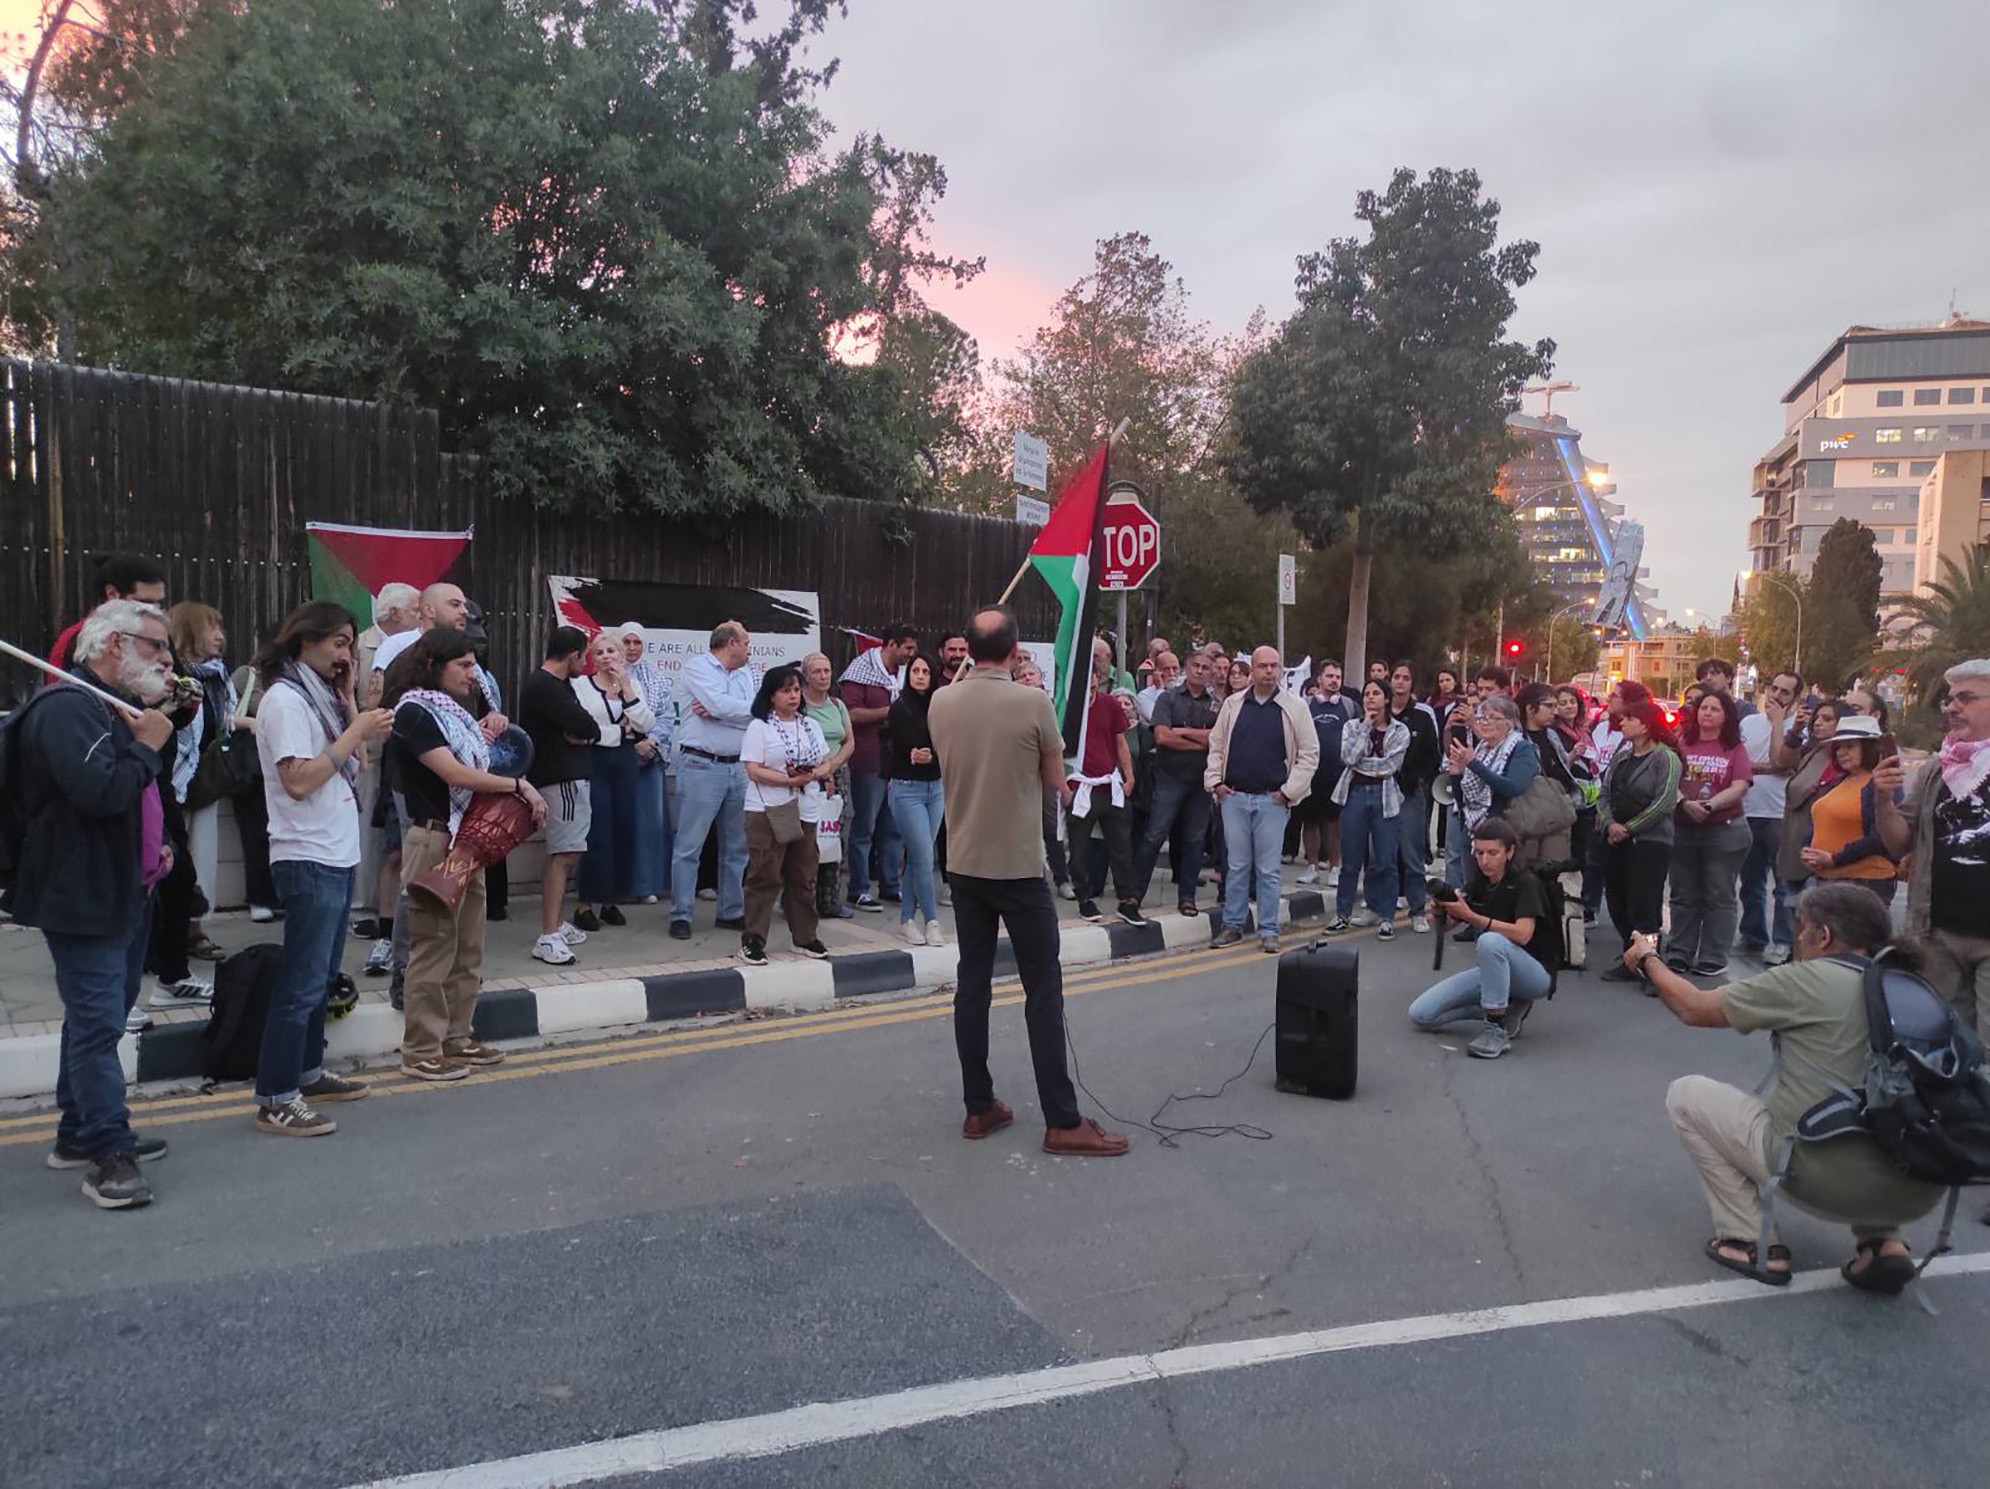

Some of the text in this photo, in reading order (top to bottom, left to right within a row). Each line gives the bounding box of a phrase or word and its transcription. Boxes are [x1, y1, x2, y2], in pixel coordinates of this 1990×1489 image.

[1820, 440, 1849, 452] pwc
[1103, 524, 1155, 568] TOP
[658, 643, 683, 655] ARE
[686, 644, 705, 655] ALL
[657, 660, 682, 672] END
